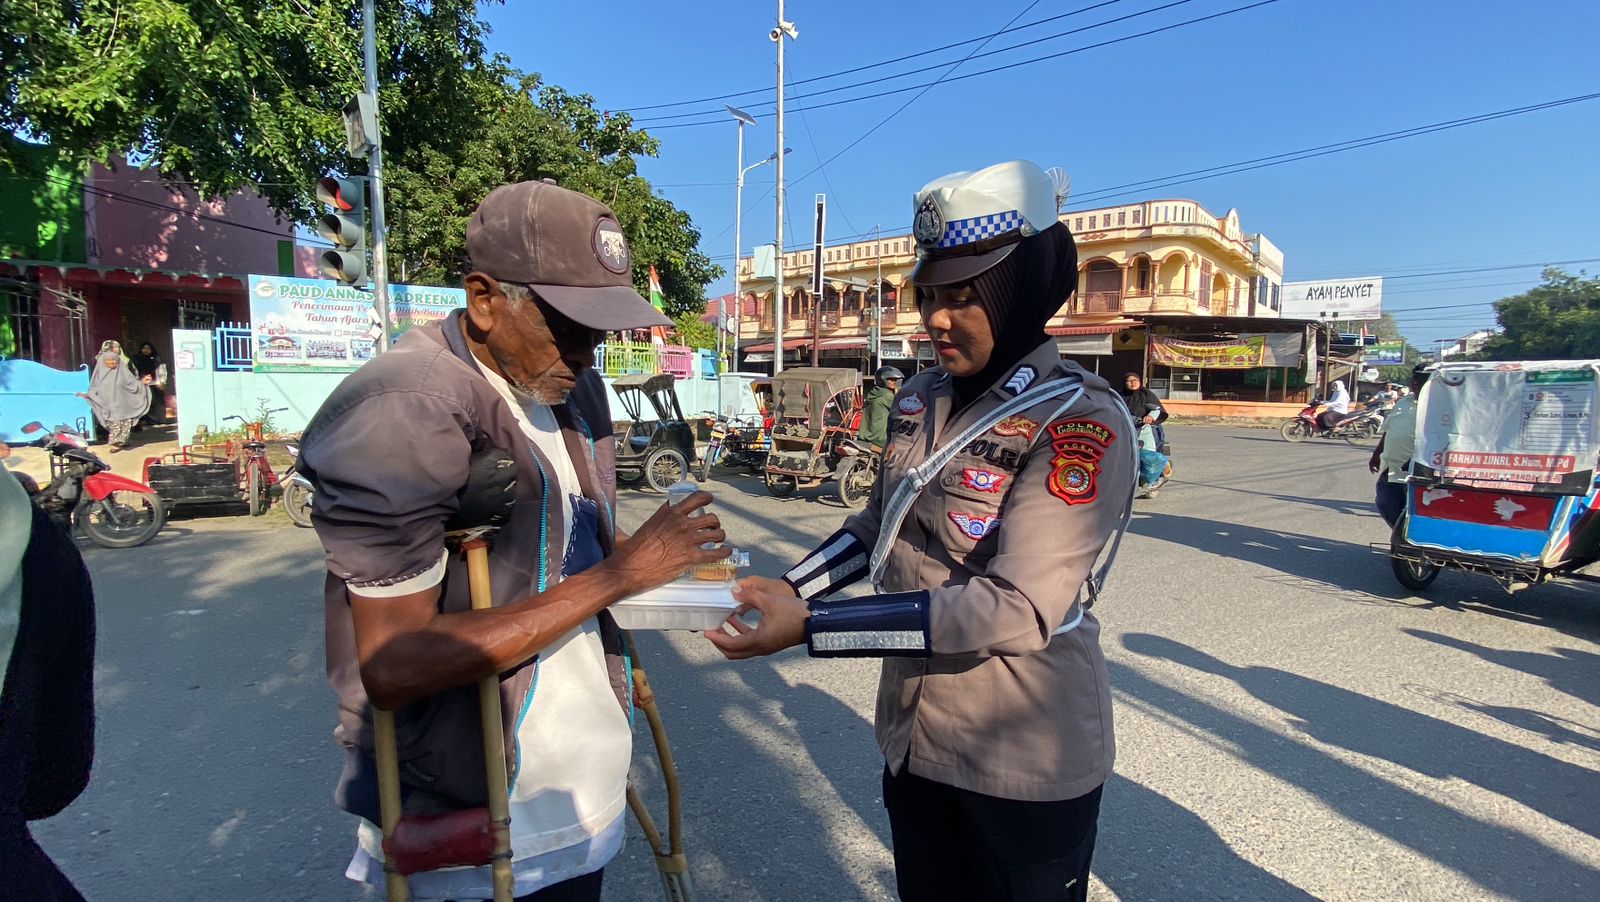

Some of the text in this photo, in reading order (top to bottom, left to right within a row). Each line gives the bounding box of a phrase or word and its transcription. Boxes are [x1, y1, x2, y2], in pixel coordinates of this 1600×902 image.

[279, 285, 321, 298] PAUD
[394, 292, 458, 305] ADREENA
[1306, 283, 1373, 300] AYAM PENYET
[292, 301, 354, 312] Penerimaan
[305, 313, 338, 323] Tahun
[340, 314, 369, 325] Ajara
[1057, 422, 1109, 438] POLRES
[1063, 443, 1094, 453] ACEH
[1432, 452, 1443, 466] 3
[1448, 453, 1481, 465] FARHAN
